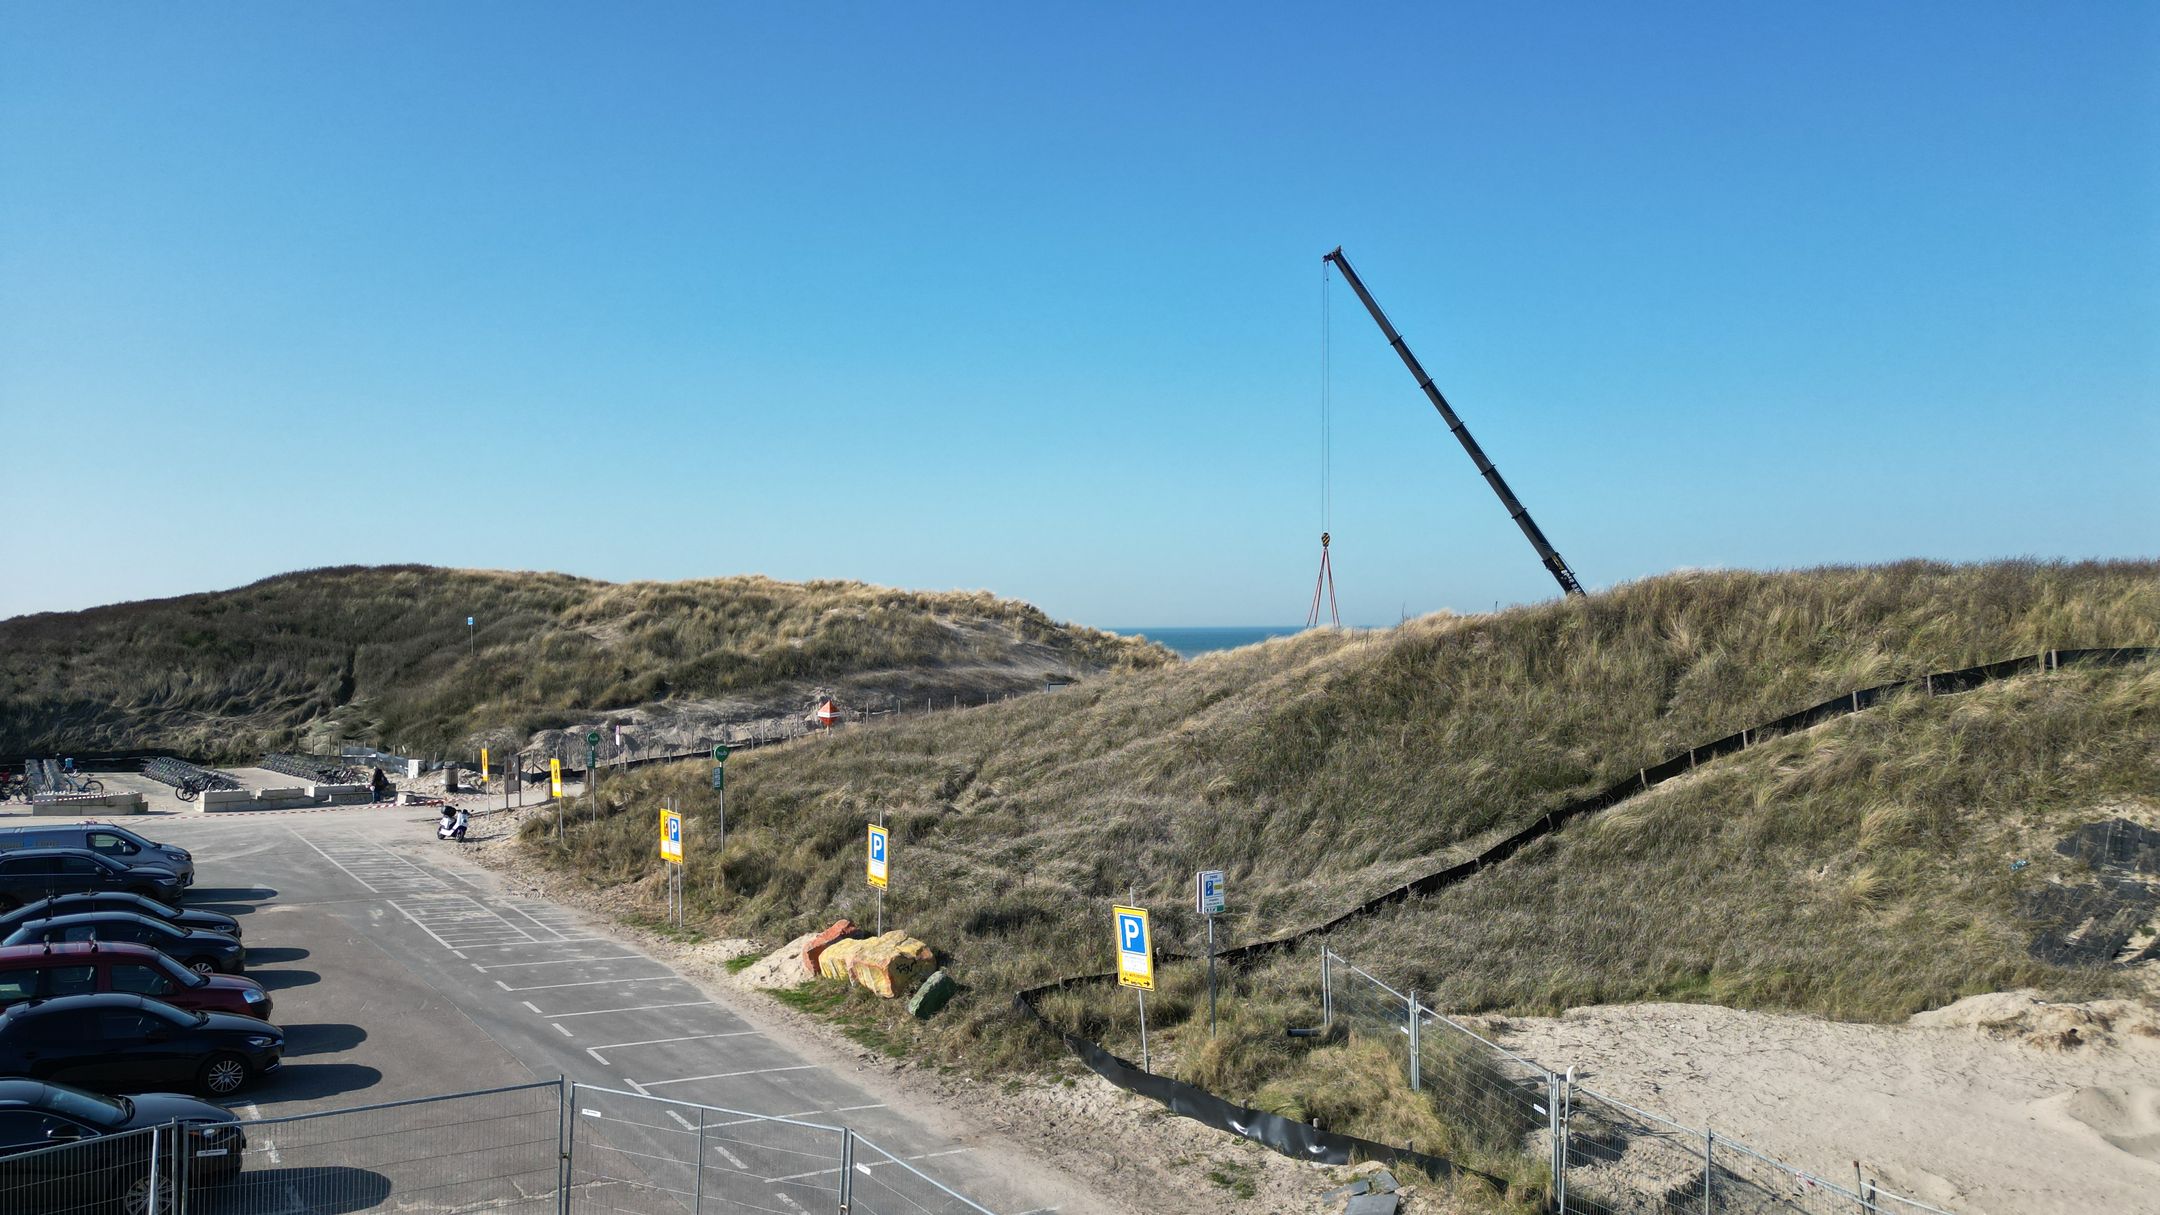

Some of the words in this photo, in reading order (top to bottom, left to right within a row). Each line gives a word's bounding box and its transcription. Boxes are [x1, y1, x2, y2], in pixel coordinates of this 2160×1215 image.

[671, 820, 678, 839] P
[873, 834, 882, 858] P
[1207, 881, 1212, 889] P
[1124, 918, 1139, 949] P
